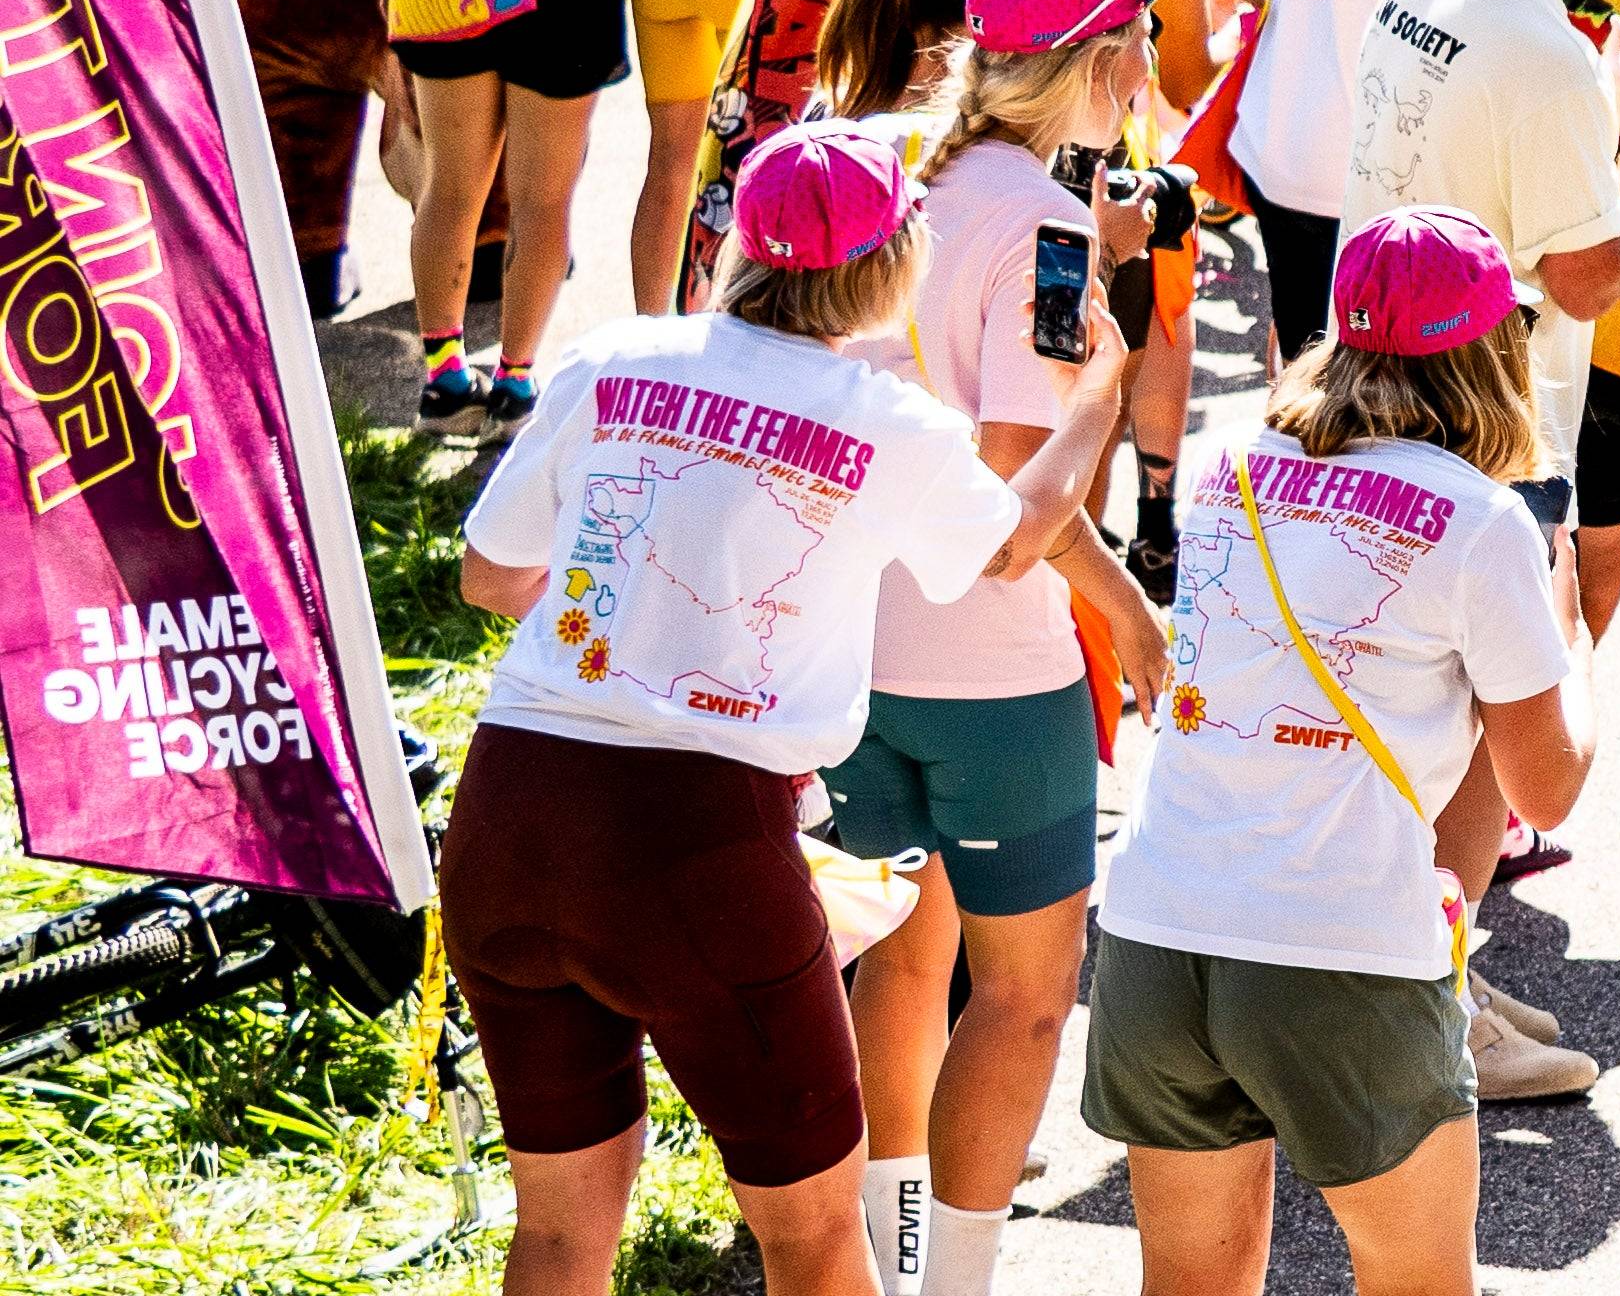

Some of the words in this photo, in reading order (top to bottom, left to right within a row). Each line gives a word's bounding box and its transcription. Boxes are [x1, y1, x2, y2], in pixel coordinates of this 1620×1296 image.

[1391, 7, 1468, 66] SOCIETY
[1419, 310, 1473, 339] ZWIFT
[594, 376, 692, 432] WATCH
[687, 388, 750, 446] THE
[740, 403, 876, 493] FEMMES
[637, 431, 694, 453] FRANCE
[694, 439, 770, 472] FEMMES
[768, 461, 806, 487] AVEC
[807, 479, 858, 507] ZWIFT
[1265, 456, 1323, 506] THE
[1316, 465, 1456, 544] FEMMES
[1276, 503, 1344, 525] FEMMES
[1343, 512, 1383, 536] AVEC
[1382, 528, 1436, 557] ZWIFT
[687, 690, 765, 724] ZWIFT
[1273, 724, 1353, 752] ZWIFT
[898, 1178, 923, 1275] CIOVITA
